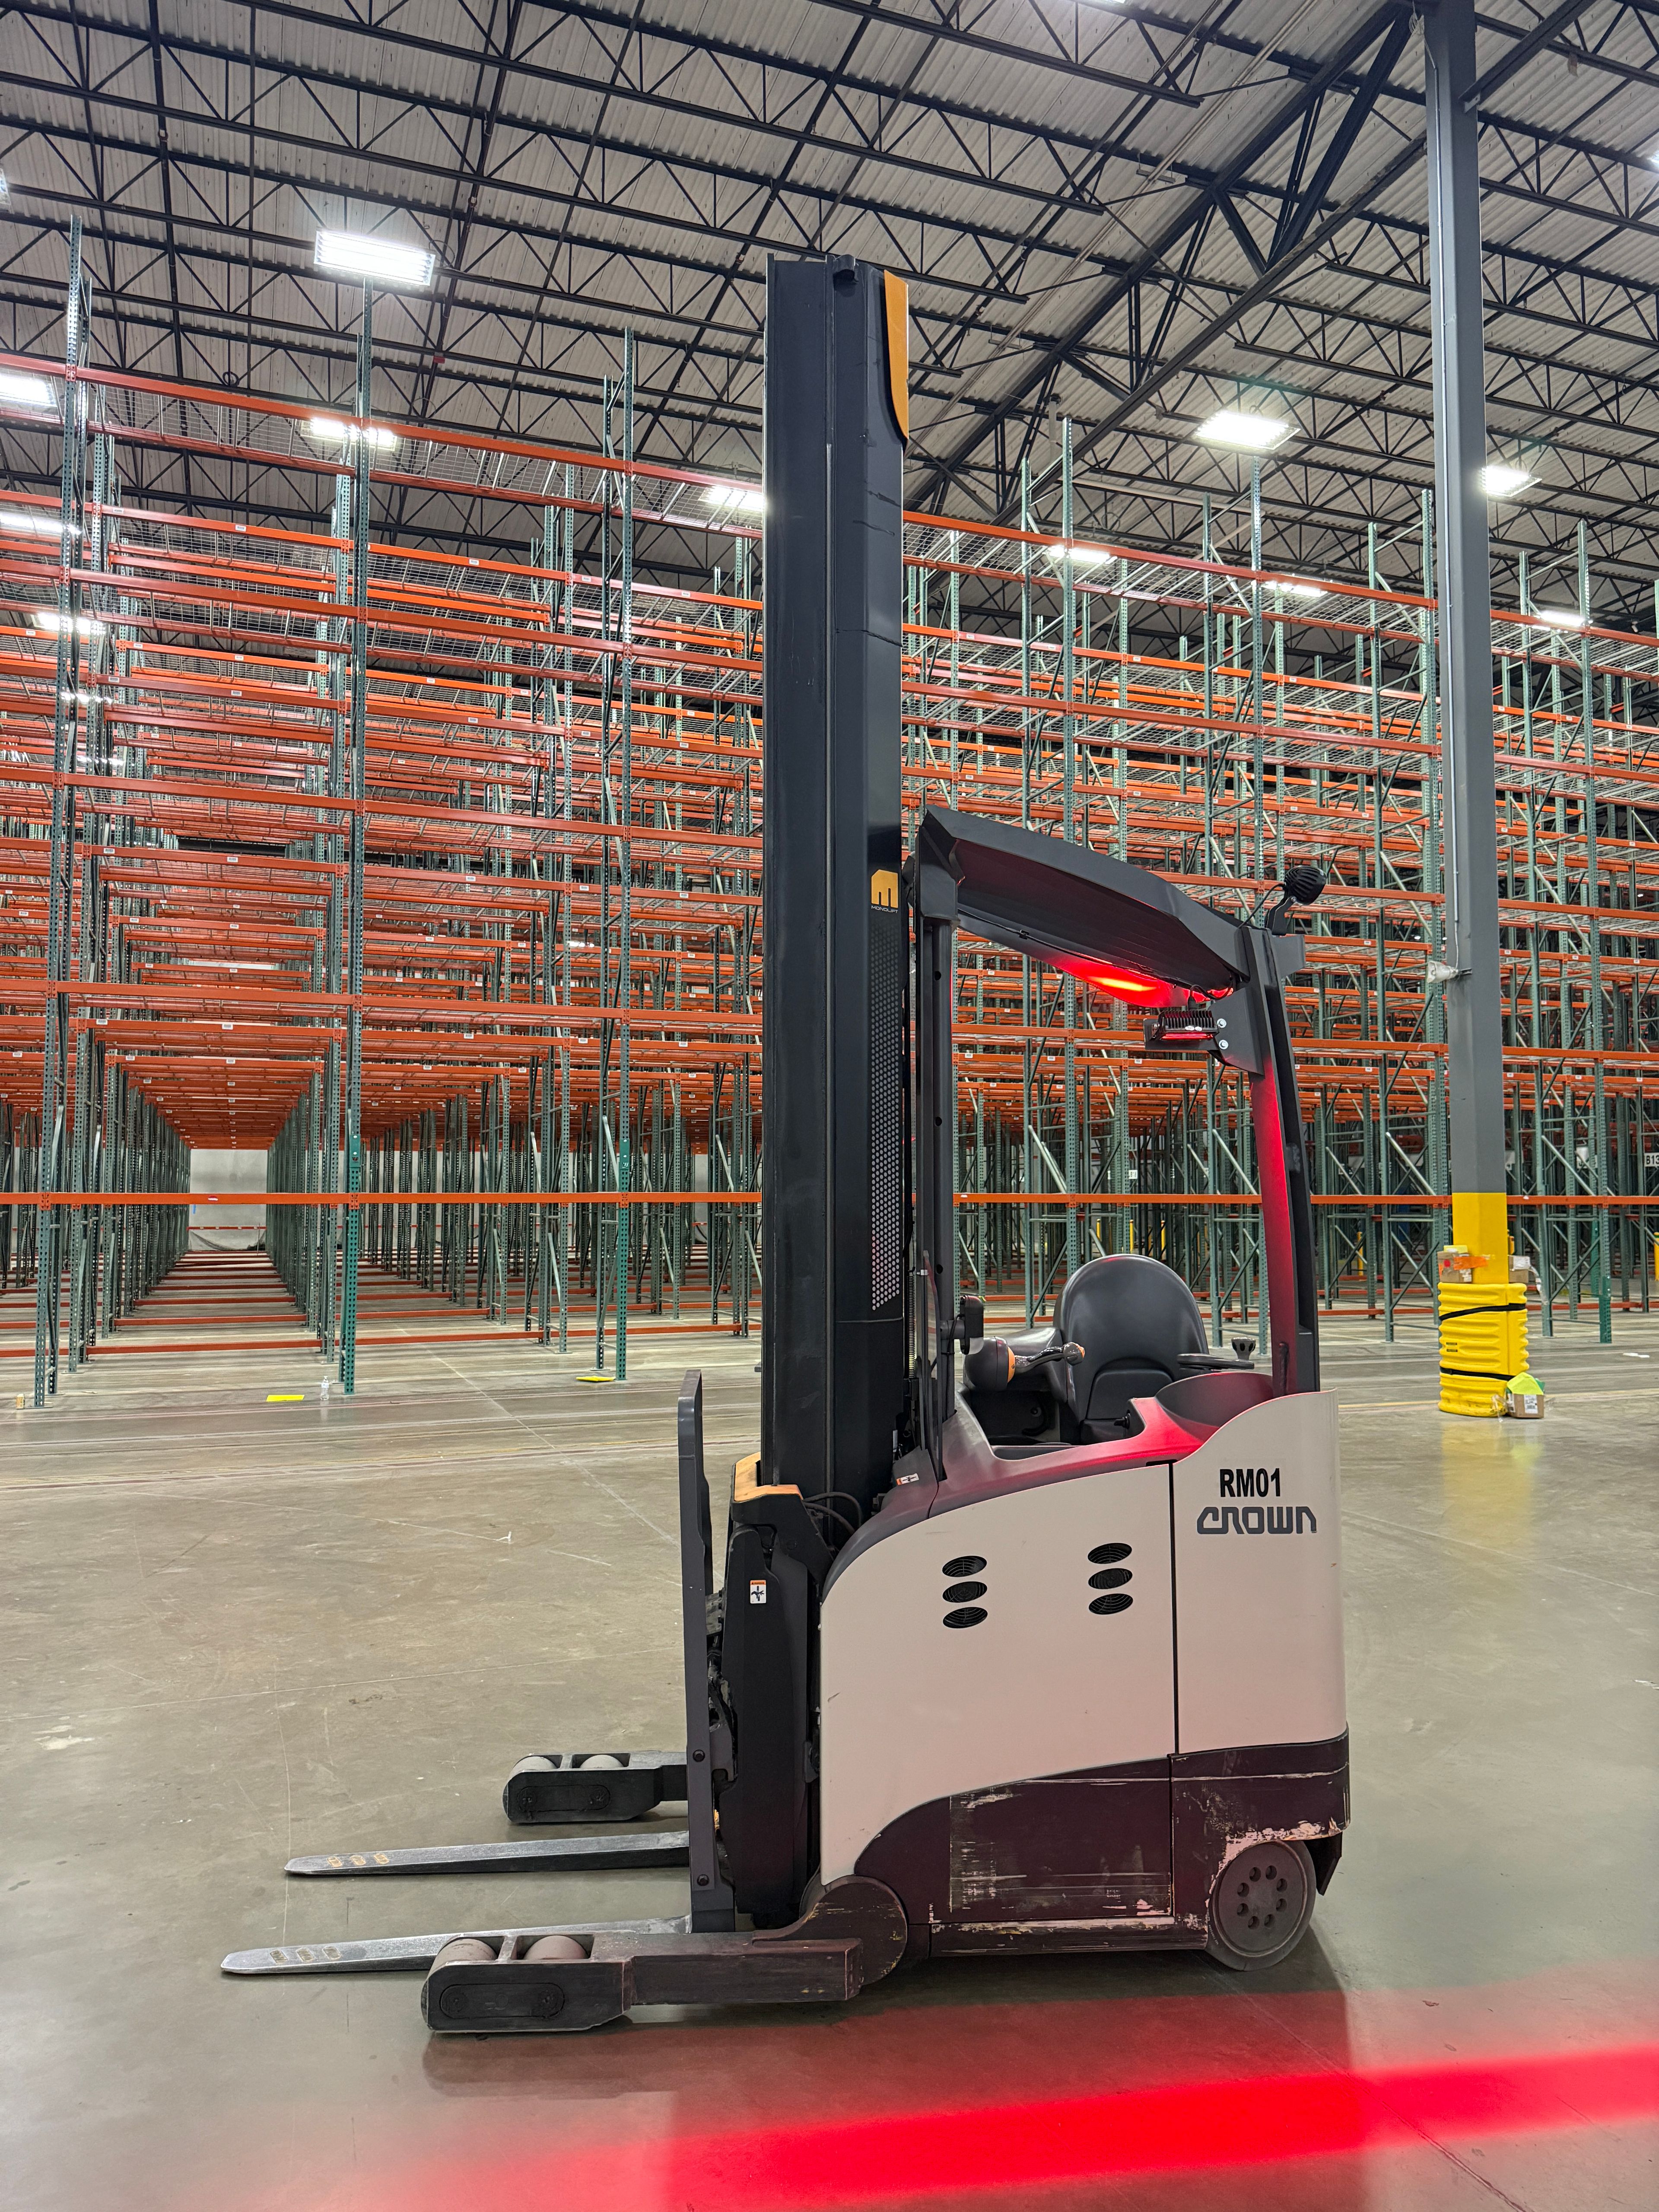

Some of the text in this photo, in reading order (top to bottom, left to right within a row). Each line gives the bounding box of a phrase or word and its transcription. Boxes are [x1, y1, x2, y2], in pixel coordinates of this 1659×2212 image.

[871, 905, 898, 914] MONOLIFT
[1220, 1468, 1281, 1497] RM01
[1197, 1506, 1317, 1535] CROWN
